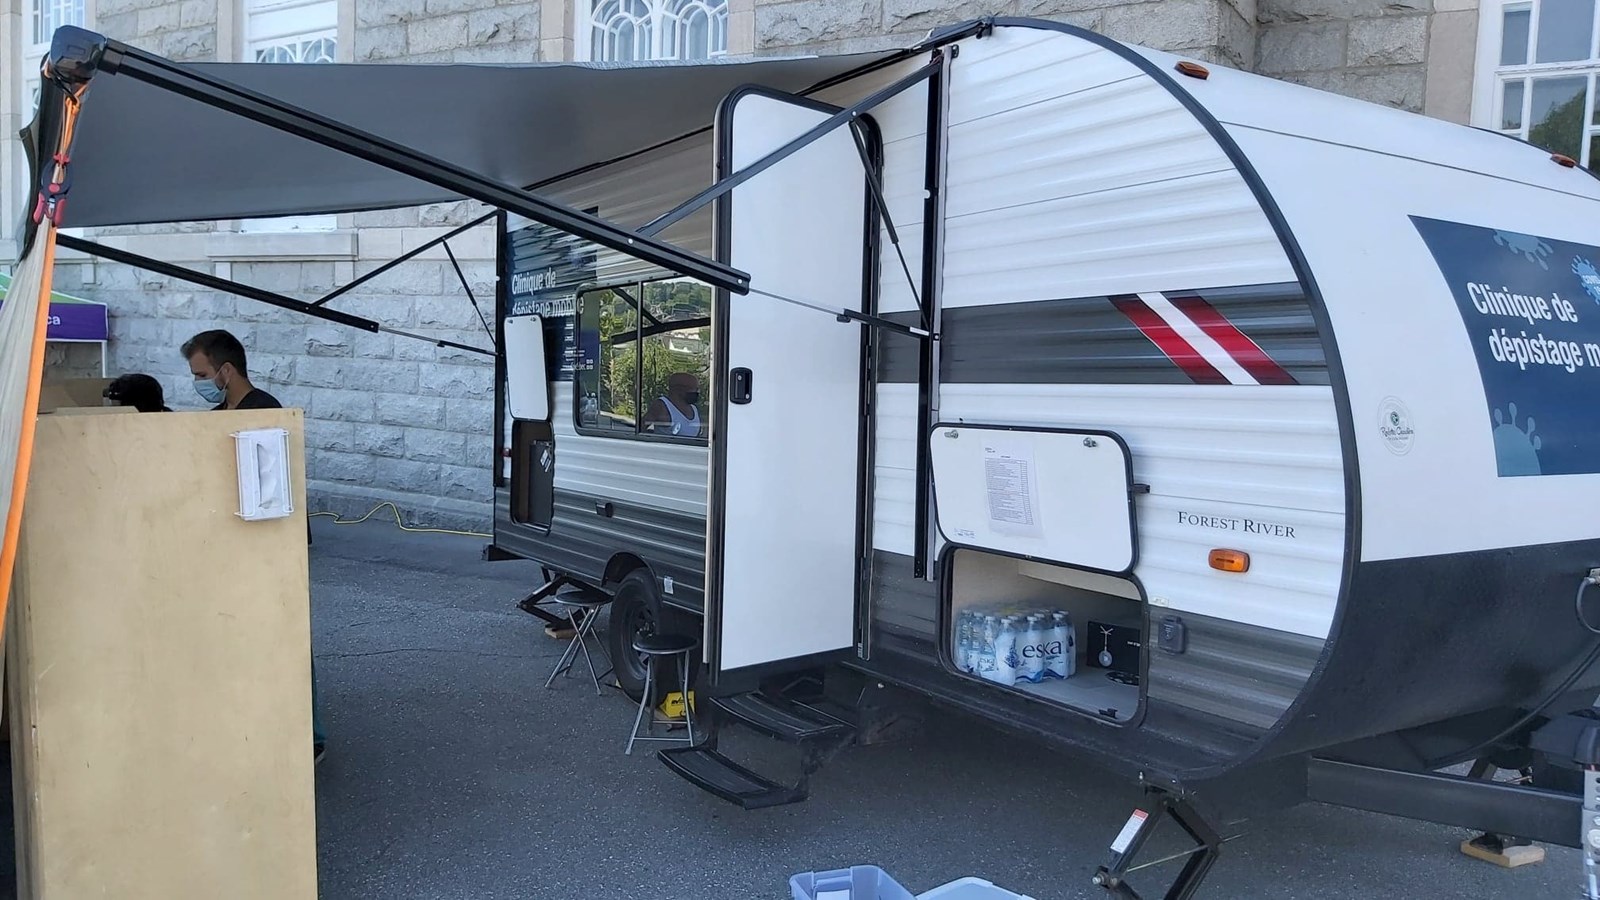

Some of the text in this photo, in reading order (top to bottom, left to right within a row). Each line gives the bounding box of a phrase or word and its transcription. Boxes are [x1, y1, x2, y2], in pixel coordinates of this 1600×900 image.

[512, 267, 556, 296] Clinique de
[1467, 282, 1578, 324] Clinique de
[1488, 328, 1584, 373] dépistage
[1177, 511, 1296, 538] FOREST RIVER
[1022, 640, 1063, 659] eska
